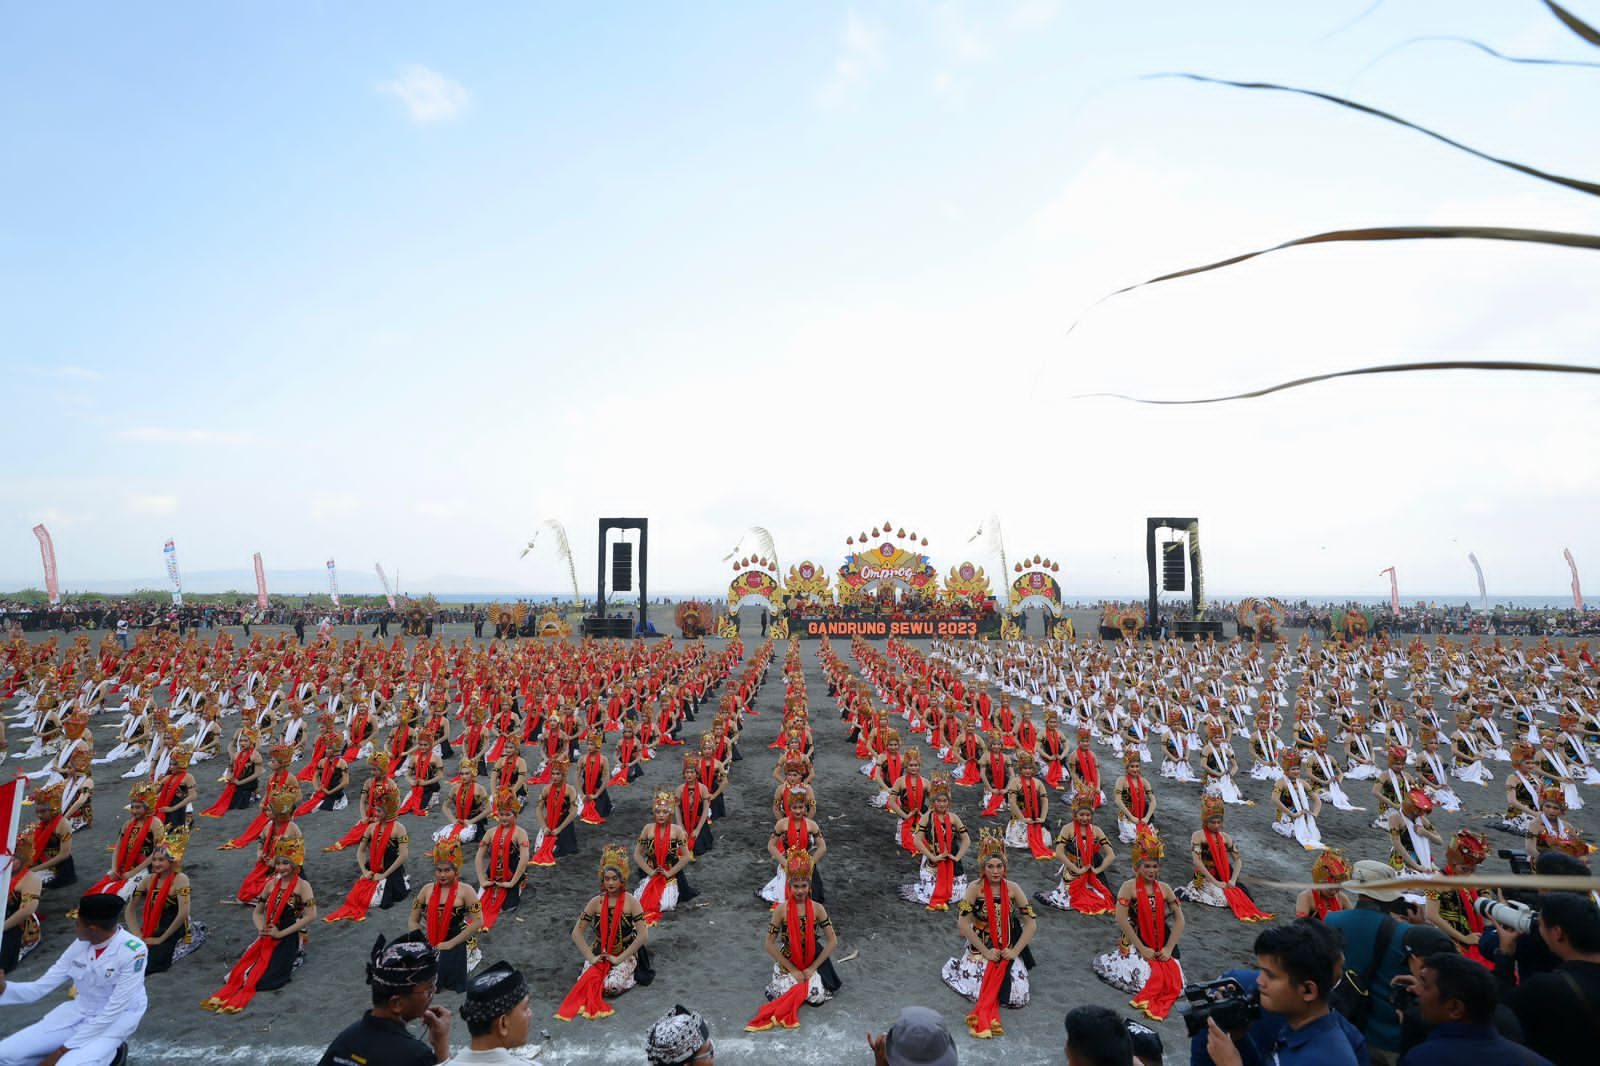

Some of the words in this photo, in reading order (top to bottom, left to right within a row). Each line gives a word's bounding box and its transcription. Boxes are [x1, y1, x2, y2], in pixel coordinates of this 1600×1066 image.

[809, 622, 886, 635] GANDRUNG
[890, 622, 933, 635] SEWU
[938, 622, 977, 635] 2023
